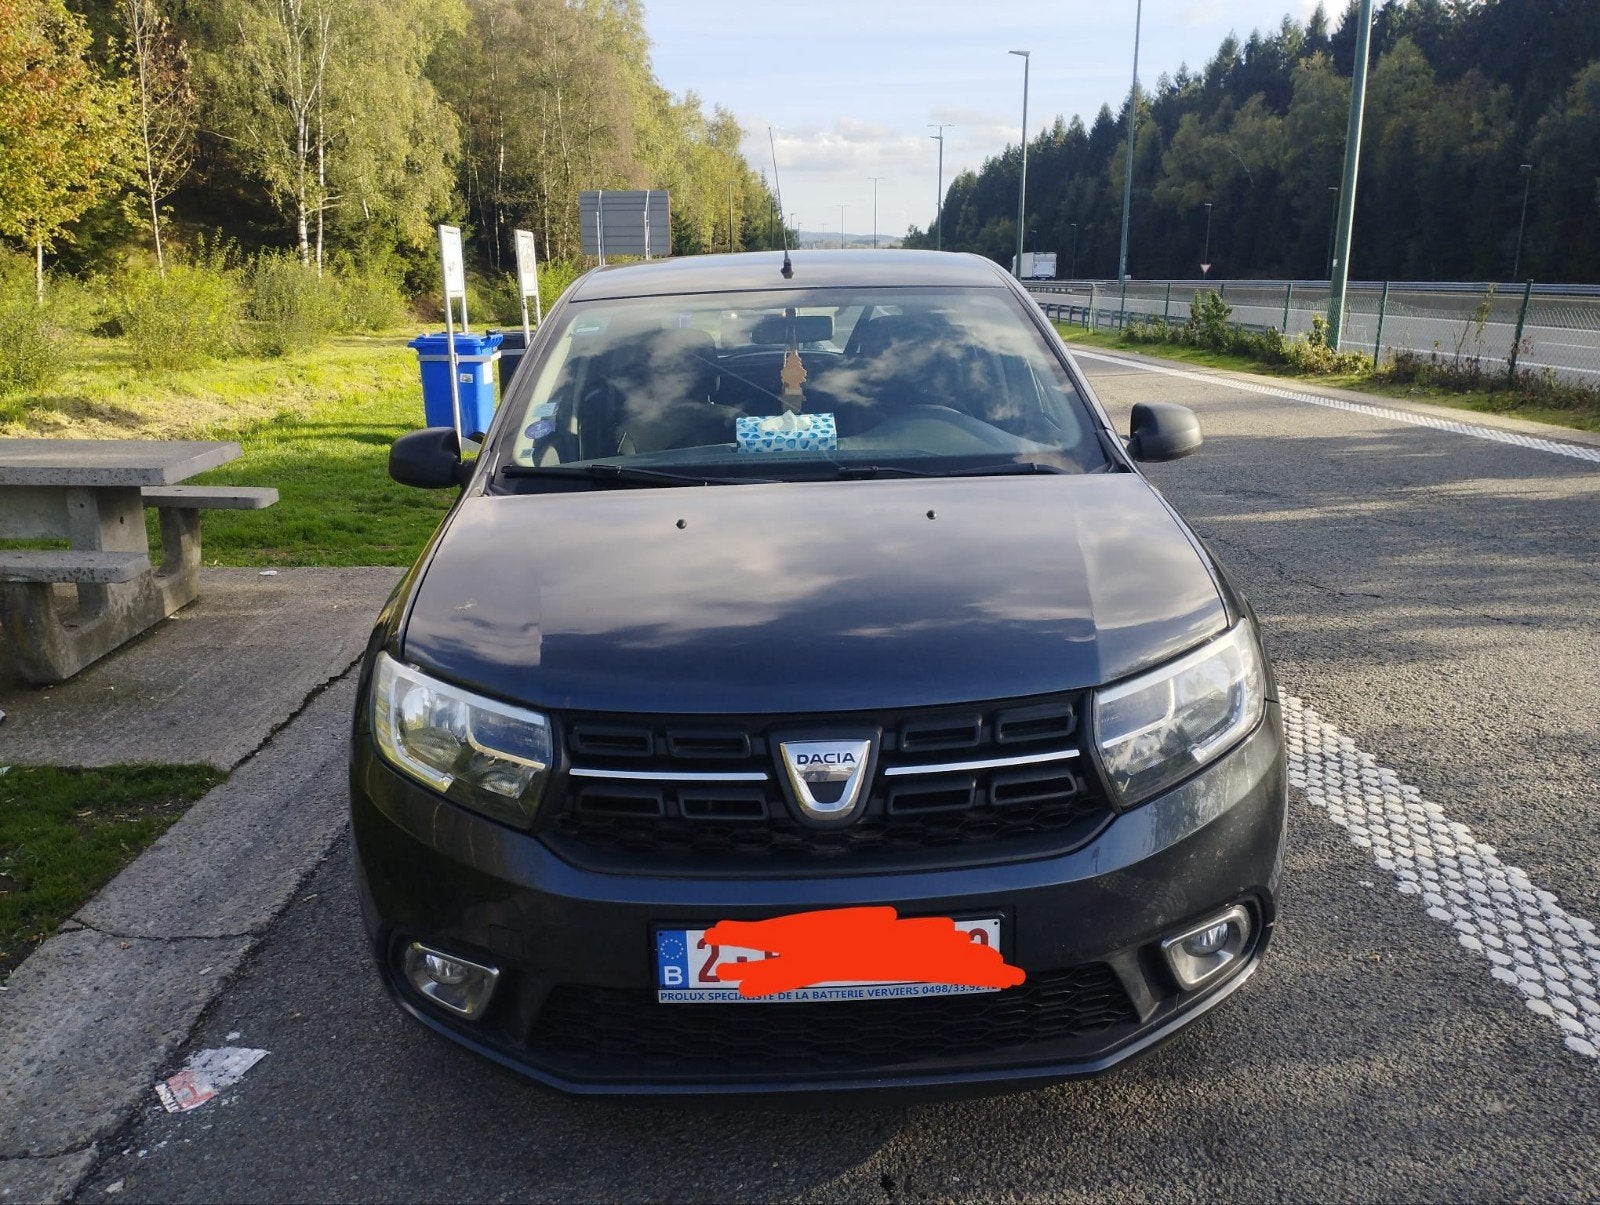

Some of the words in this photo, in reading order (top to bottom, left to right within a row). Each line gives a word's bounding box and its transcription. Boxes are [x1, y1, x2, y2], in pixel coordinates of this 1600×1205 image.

[796, 752, 856, 765] DACIA
[664, 965, 683, 985] B
[660, 992, 705, 1001] PROLUX
[777, 991, 792, 1000] DE
[795, 990, 809, 1000] LA
[812, 988, 864, 999] BATTERIE
[867, 986, 919, 998] VERVIERS
